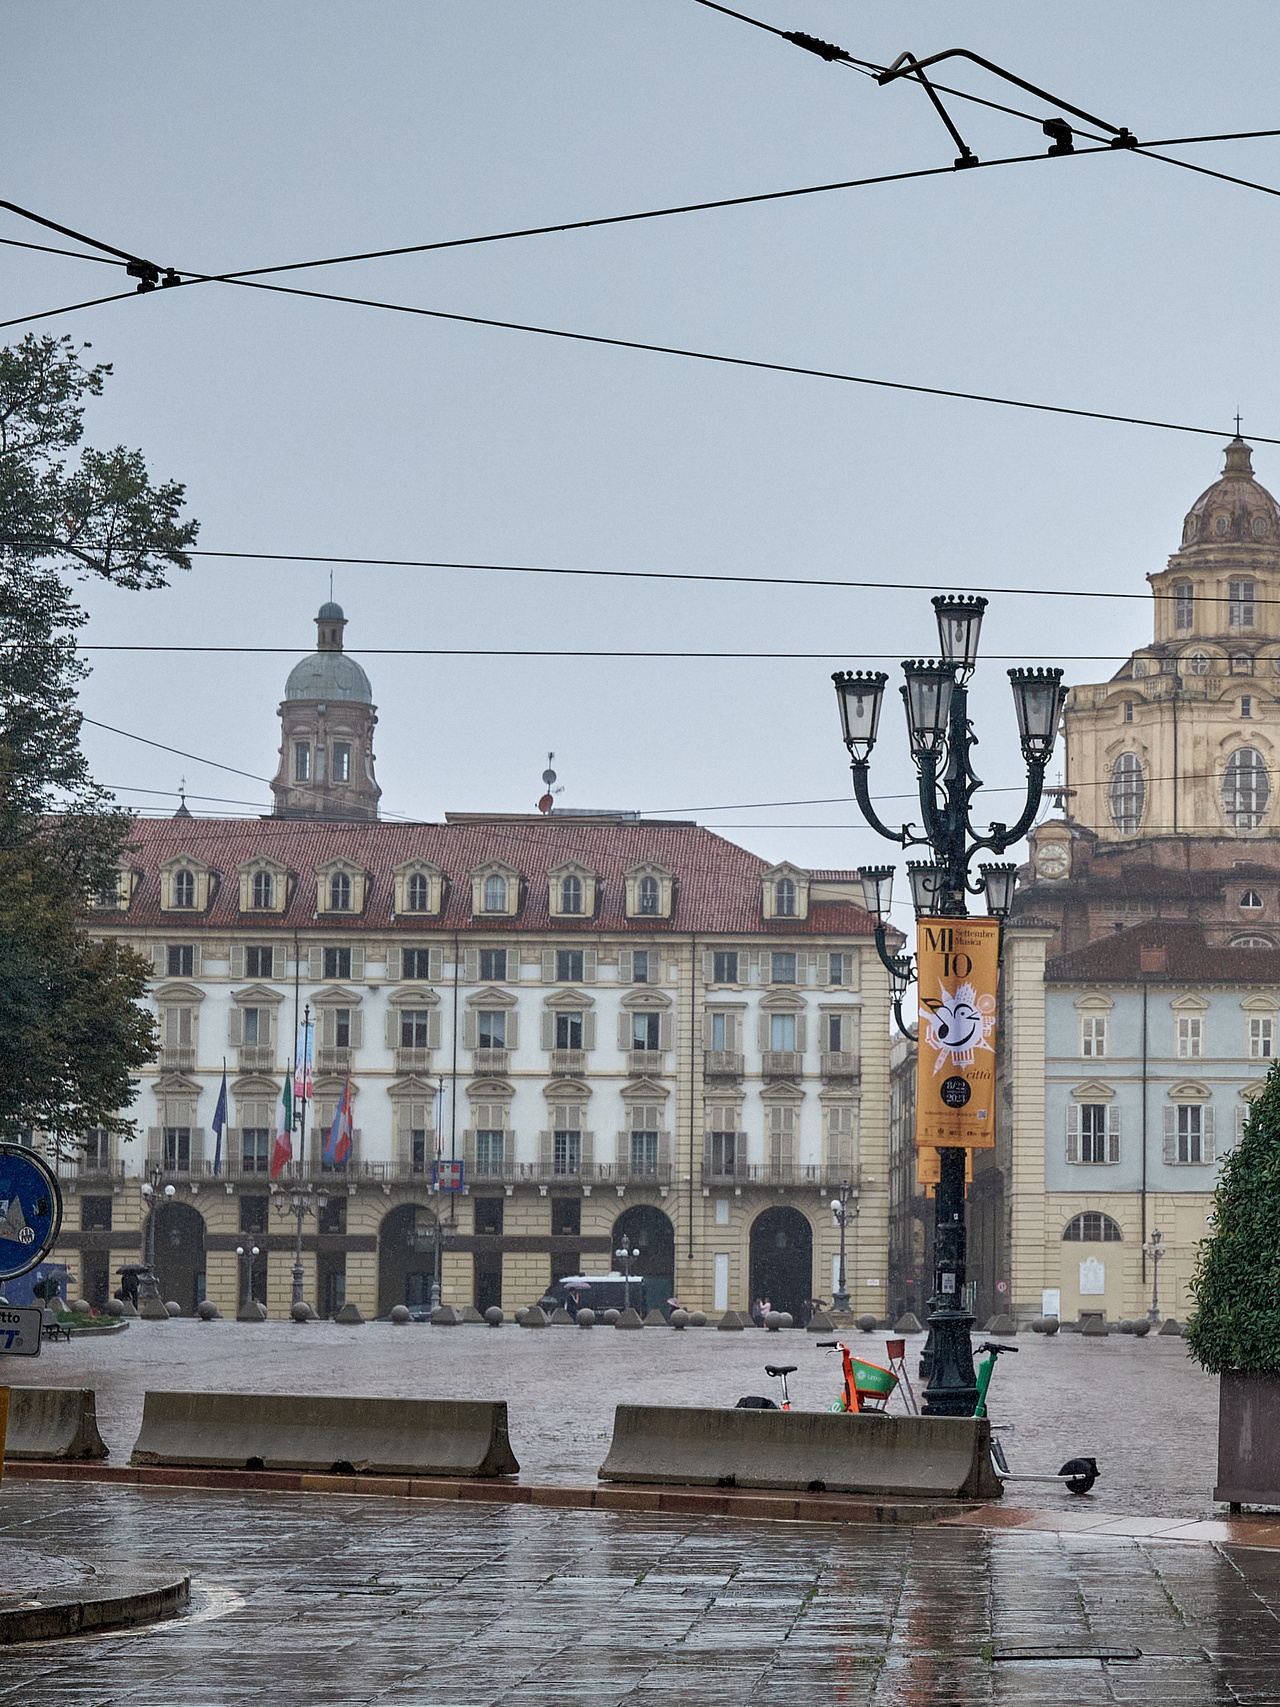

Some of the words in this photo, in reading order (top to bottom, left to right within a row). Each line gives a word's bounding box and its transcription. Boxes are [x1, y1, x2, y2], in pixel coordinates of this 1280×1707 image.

[955, 929, 995, 938] Settembre
[923, 927, 953, 952] MI
[955, 936, 981, 946] Musica
[937, 952, 972, 978] TO
[966, 1069, 990, 1080] città
[946, 1093, 966, 1103] 2023
[0, 1311, 21, 1323] tto
